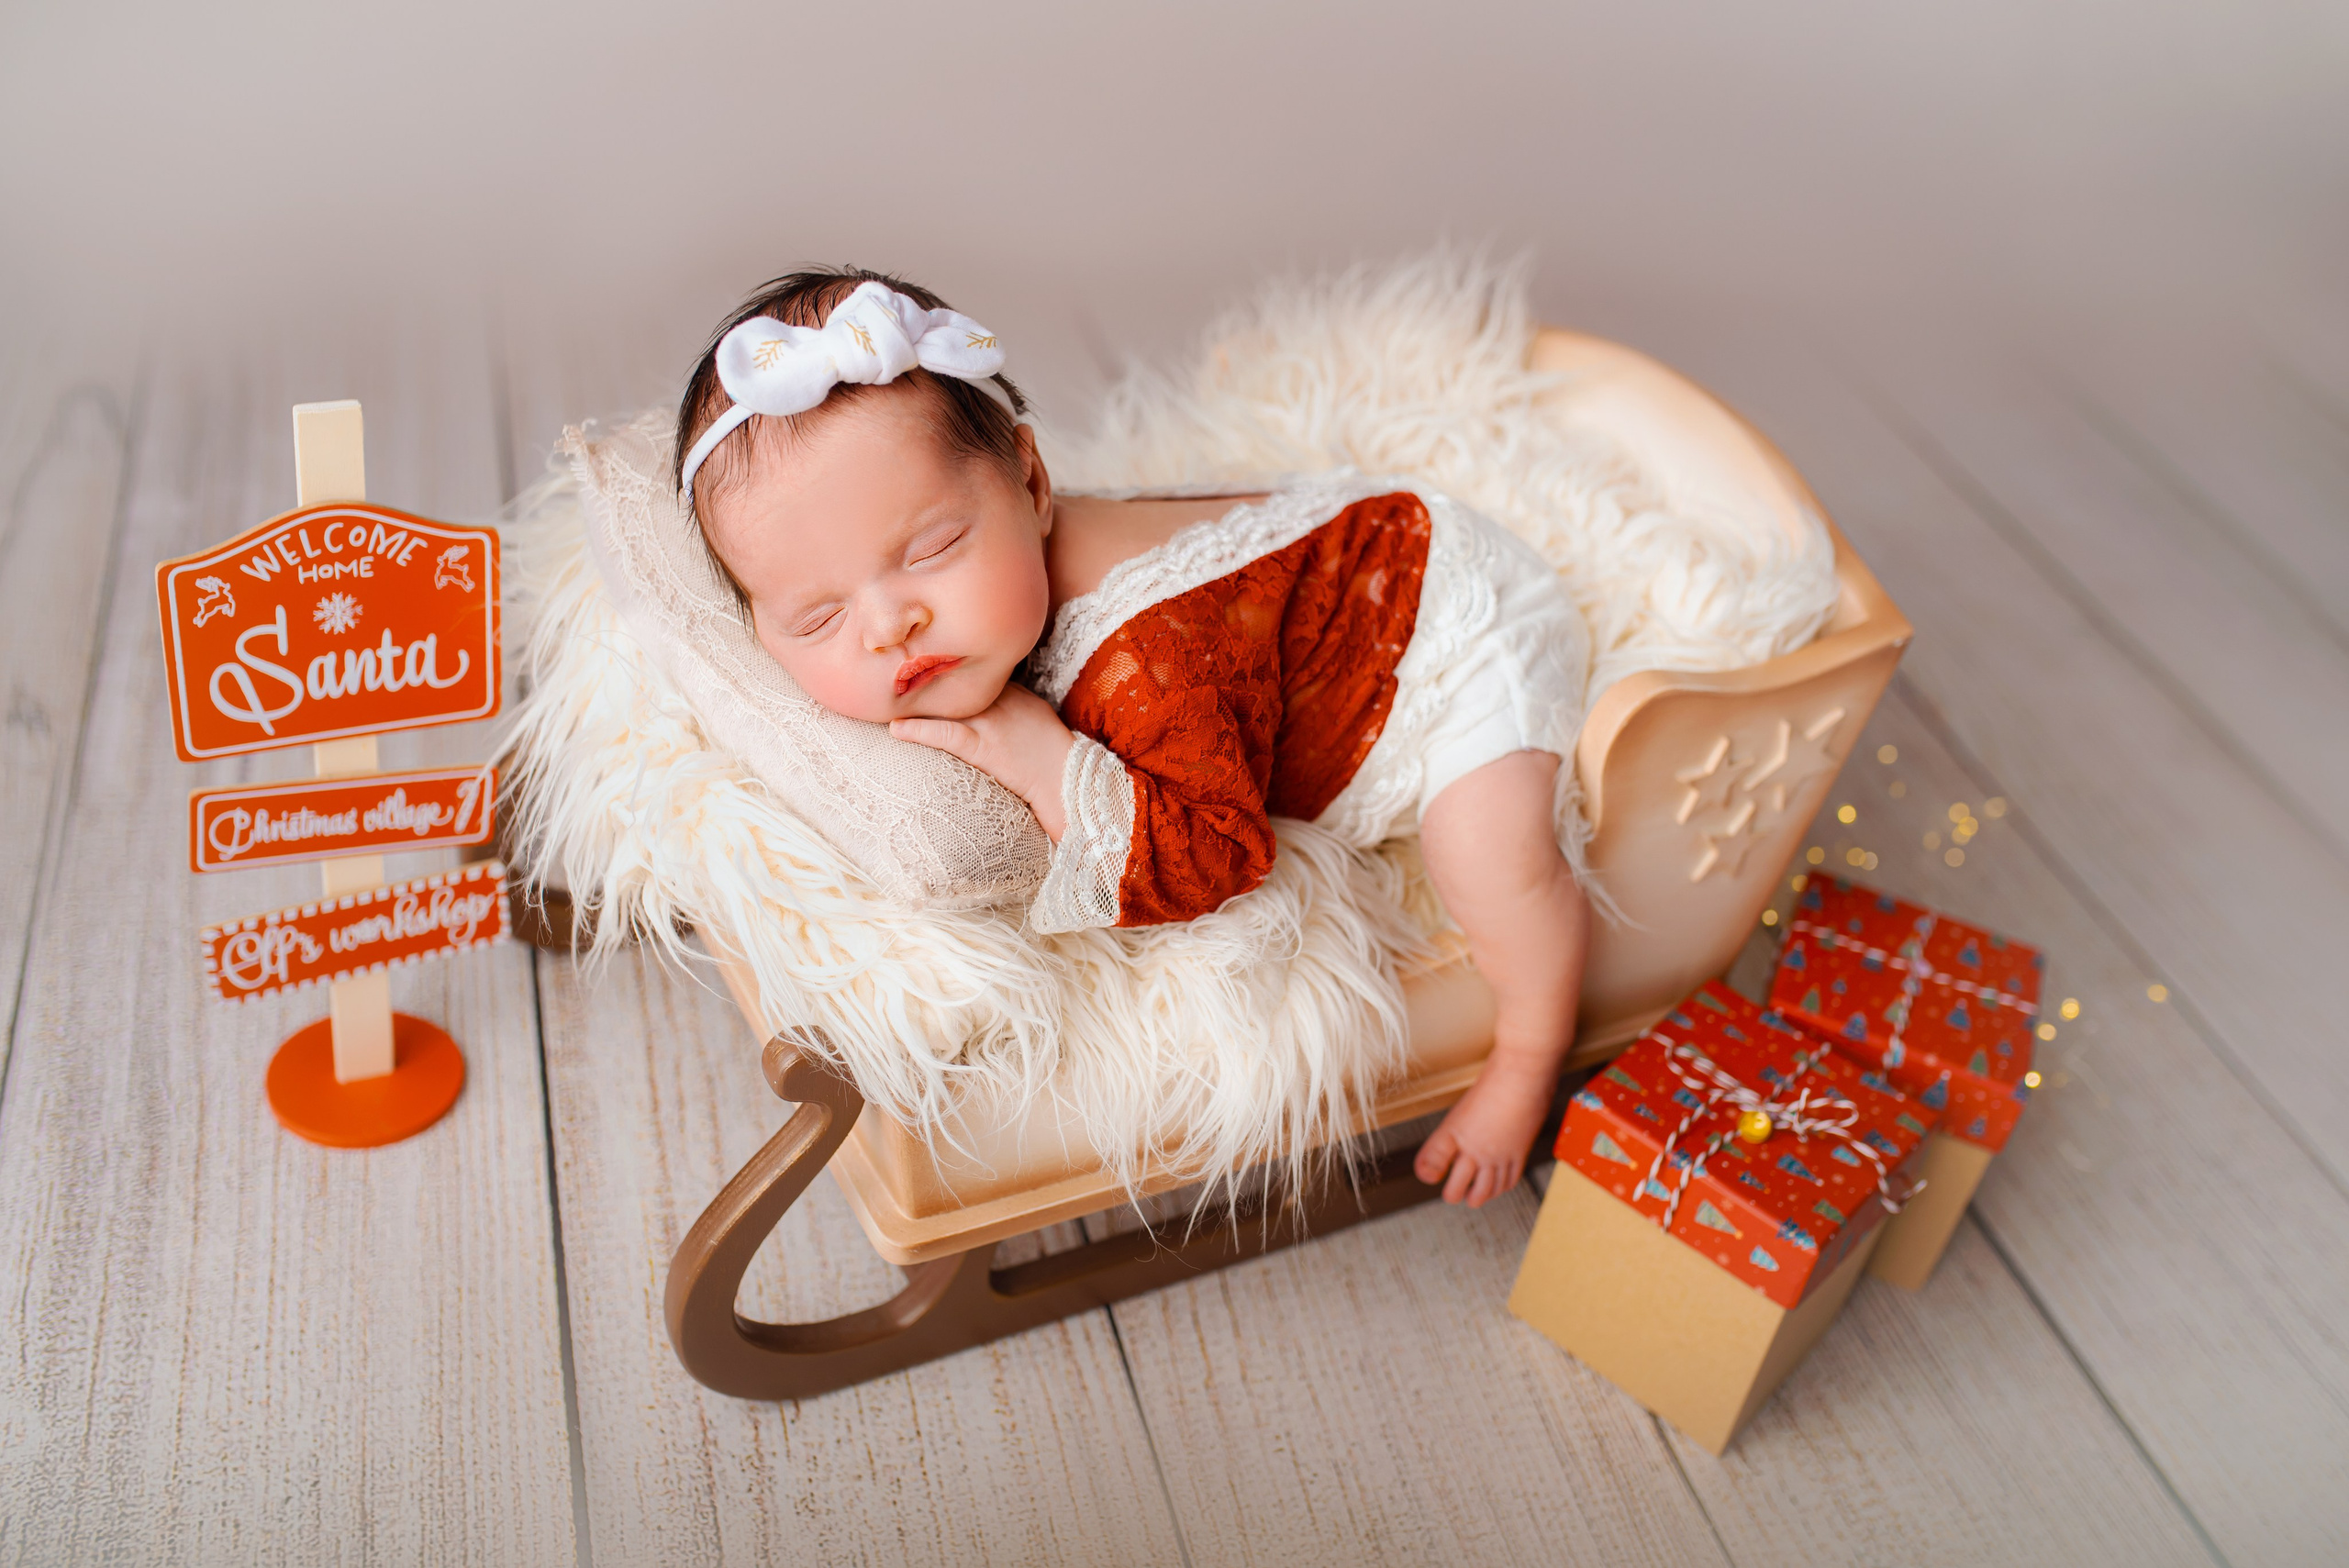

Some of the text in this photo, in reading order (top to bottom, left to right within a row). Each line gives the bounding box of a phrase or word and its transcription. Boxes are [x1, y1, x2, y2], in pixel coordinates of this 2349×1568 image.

[239, 521, 429, 582] WELCOME
[297, 555, 375, 584] HOME
[208, 604, 471, 737] Santa
[208, 787, 455, 862] Christmas village
[328, 885, 495, 947] workshop
